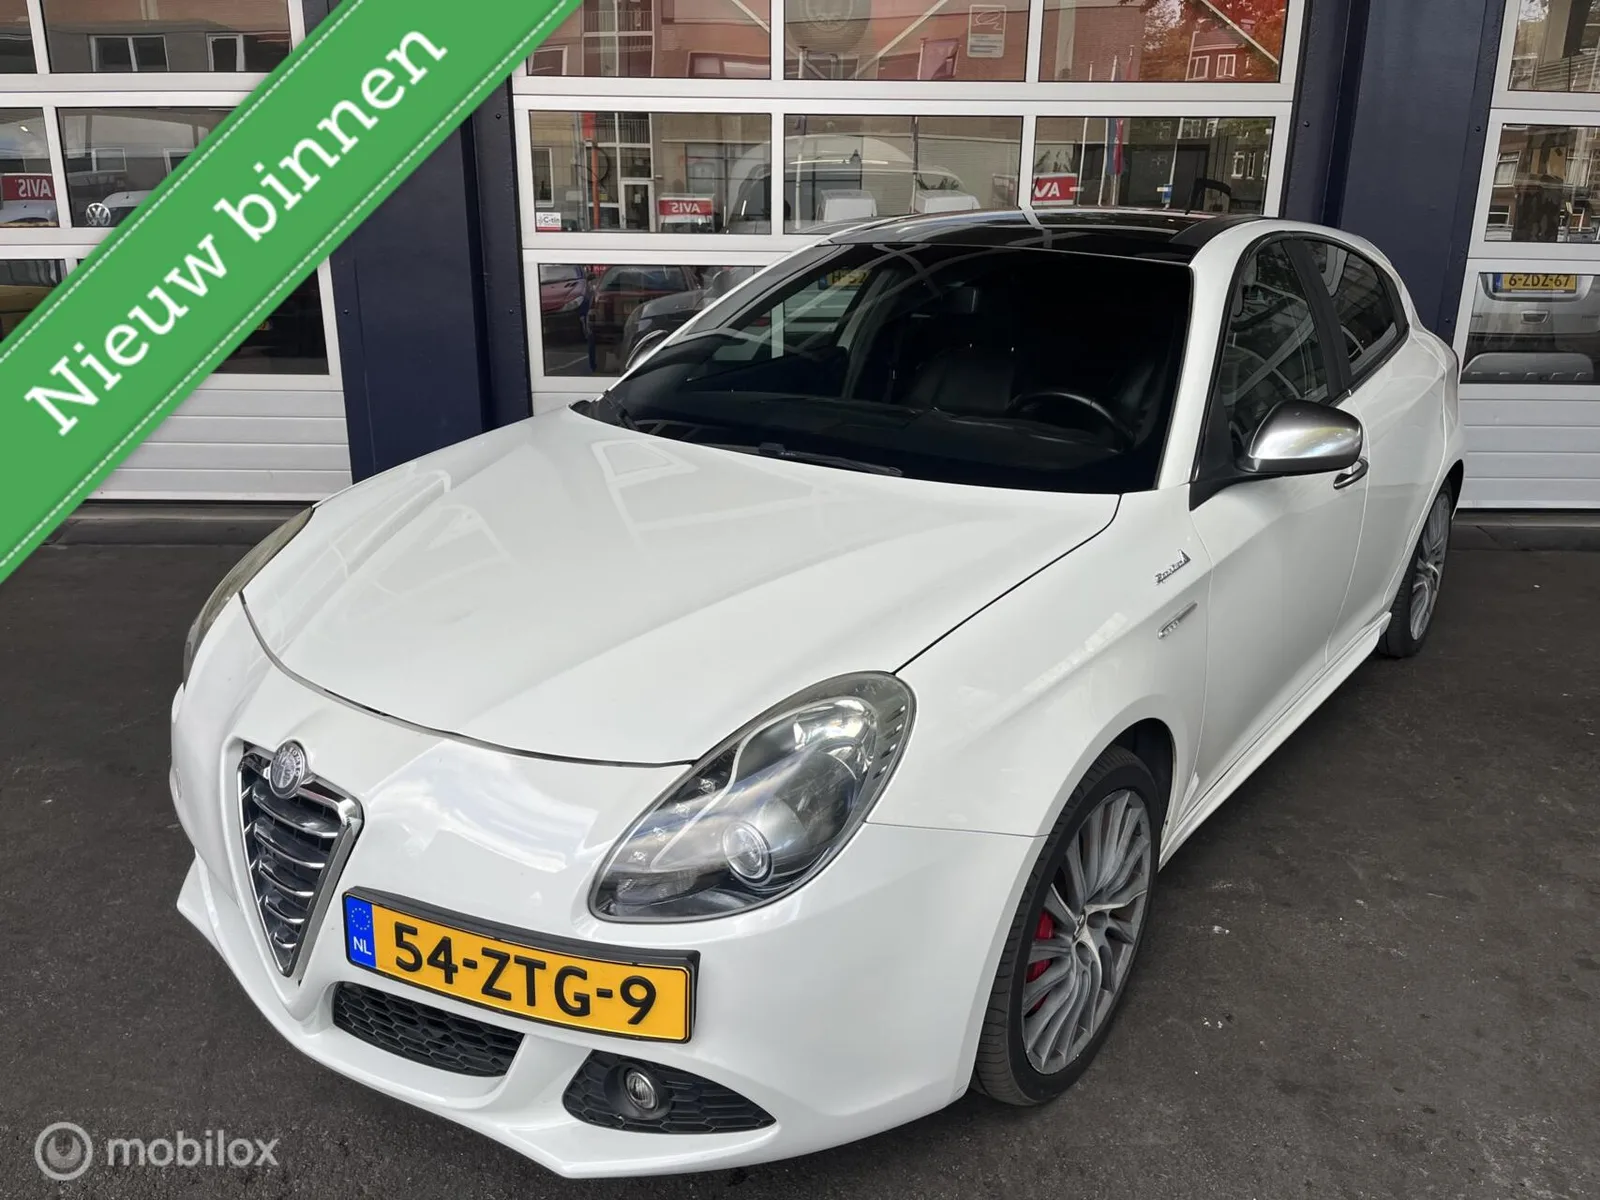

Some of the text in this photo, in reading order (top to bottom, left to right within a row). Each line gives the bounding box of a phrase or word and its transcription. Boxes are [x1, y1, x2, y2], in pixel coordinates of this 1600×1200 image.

[1508, 274, 1571, 287] 6-ZDZ-67
[353, 935, 372, 956] NL
[393, 920, 657, 1026] 54-ZTG-9
